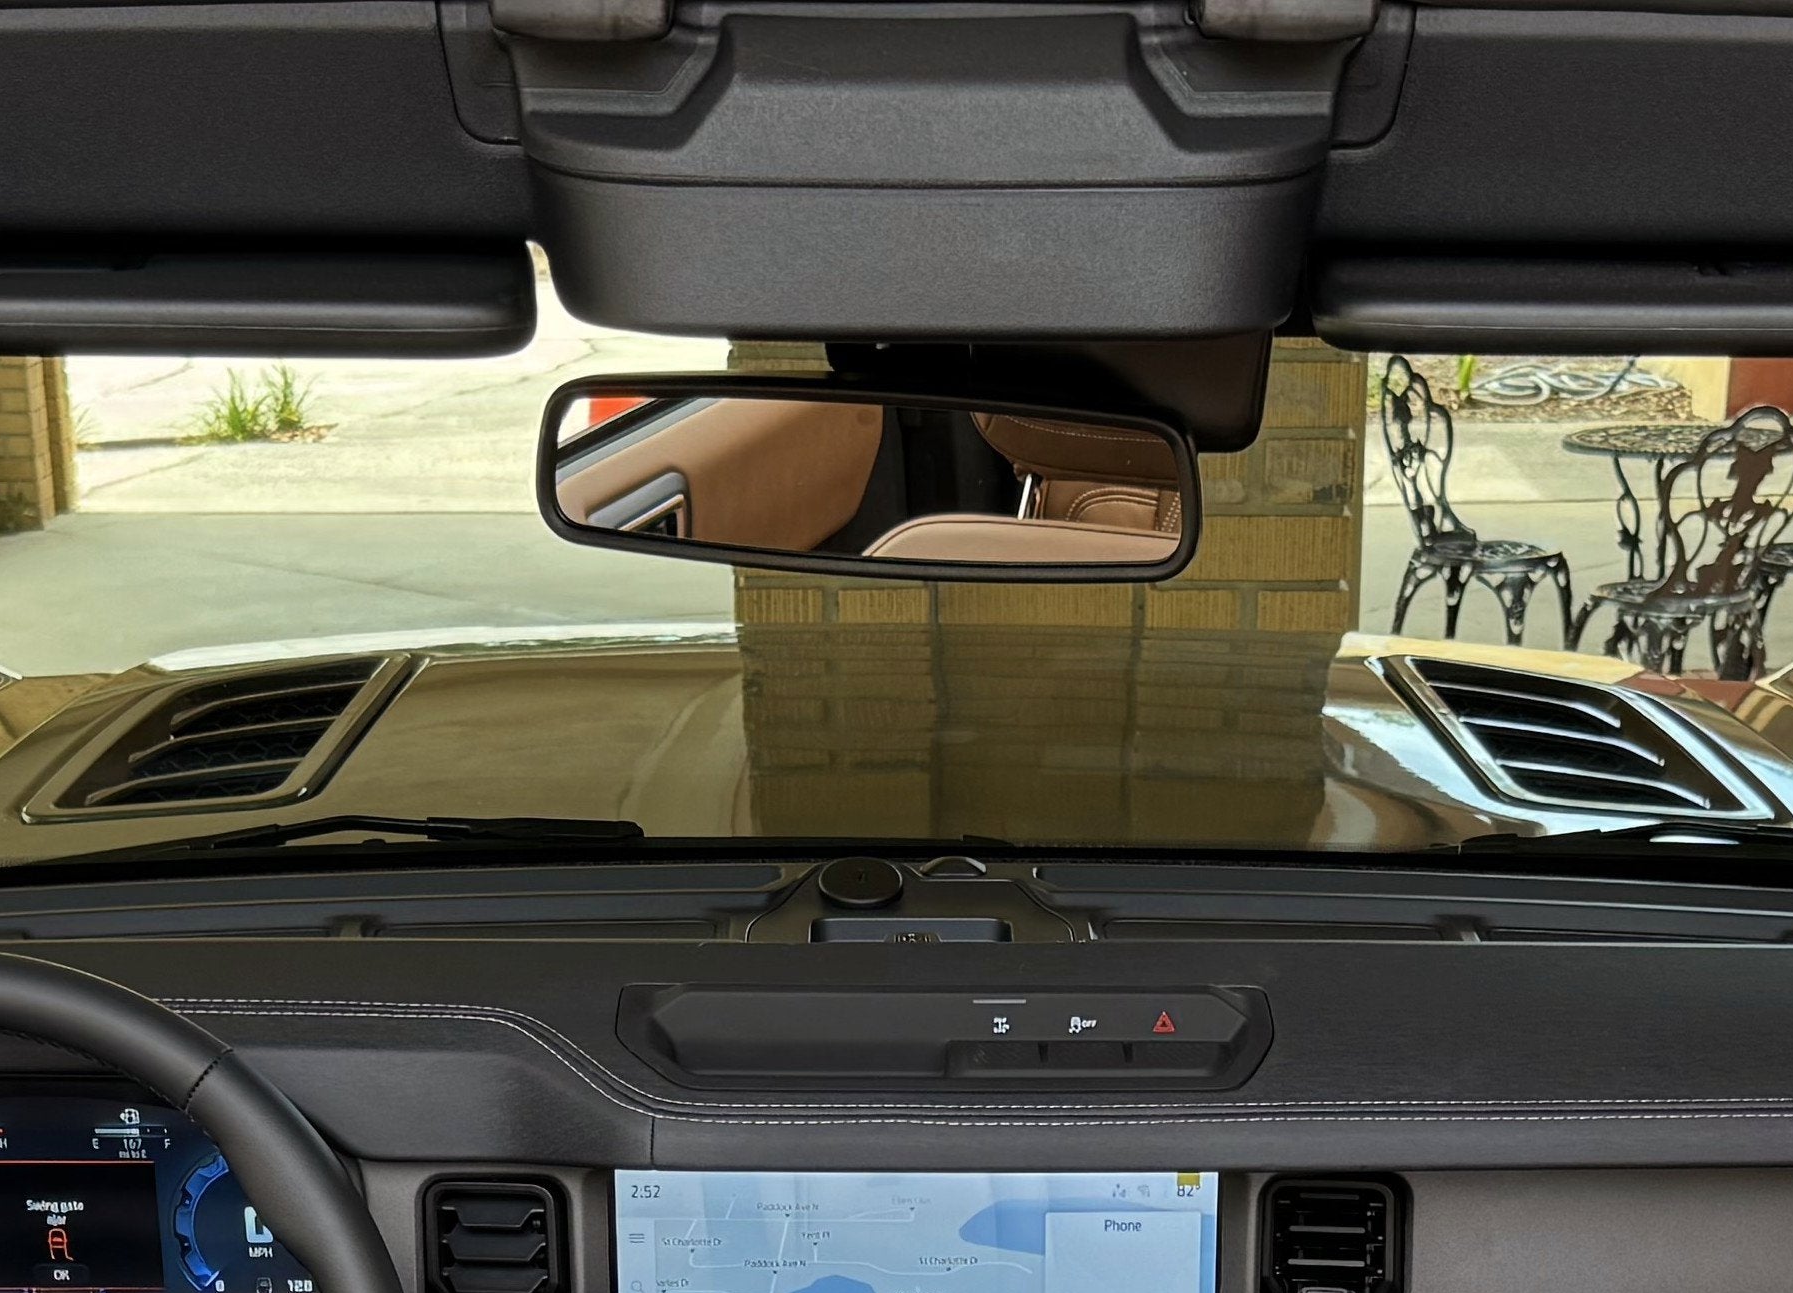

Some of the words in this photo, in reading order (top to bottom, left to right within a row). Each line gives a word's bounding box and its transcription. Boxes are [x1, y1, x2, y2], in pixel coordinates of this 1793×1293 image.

[1082, 1019, 1097, 1028] OFF
[0, 1138, 7, 1149] H
[92, 1138, 99, 1149] E
[164, 1138, 171, 1149] F
[631, 1185, 661, 1198] 2:52
[26, 1200, 58, 1213] Swing
[1104, 1219, 1142, 1232] Phone
[248, 1247, 273, 1258] MPH
[744, 1260, 780, 1268] Paddock
[782, 1260, 798, 1268] Ave
[800, 1260, 807, 1268] N
[53, 1269, 70, 1281] OK
